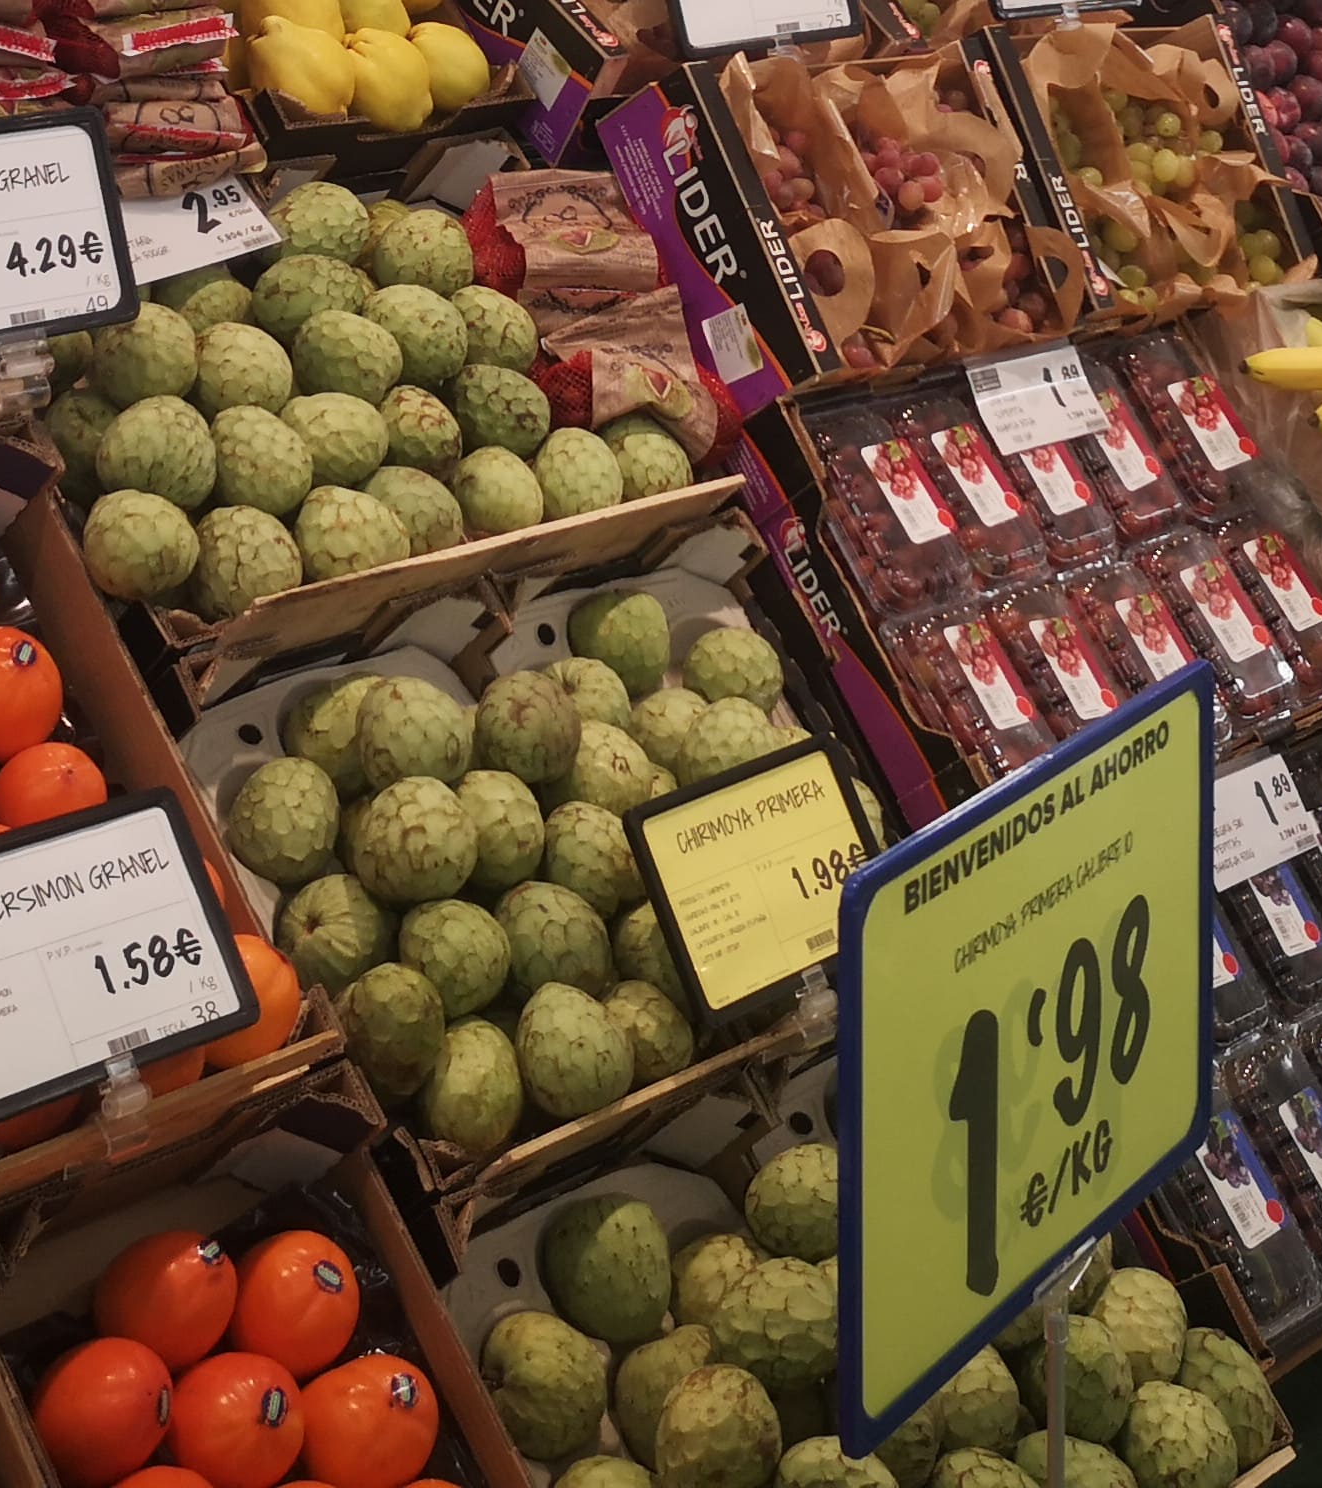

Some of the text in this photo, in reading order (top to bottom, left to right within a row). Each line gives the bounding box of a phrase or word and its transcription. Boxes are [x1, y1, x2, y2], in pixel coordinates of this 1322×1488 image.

[663, 137, 738, 285] LIDER
[1053, 174, 1091, 250] LIDER
[6, 231, 104, 278] 4.29€
[96, 274, 112, 289] Kg
[760, 217, 805, 301] LIDER
[784, 546, 841, 639] LIDER
[677, 779, 825, 854] CHIRIMOYA PRIMERA
[903, 719, 1171, 915] BIENVENIDOS AL AHORRO
[89, 847, 170, 891] GRANEL
[791, 843, 868, 900] 1.98€
[953, 842, 1124, 974] CHIRIMOYA PRIMERA CALIBRE
[95, 927, 203, 994] 1.58€
[200, 974, 219, 991] Kg
[191, 1000, 222, 1025] 38
[948, 893, 1152, 1297] 1'98
[1019, 1117, 1114, 1229] €/KG
